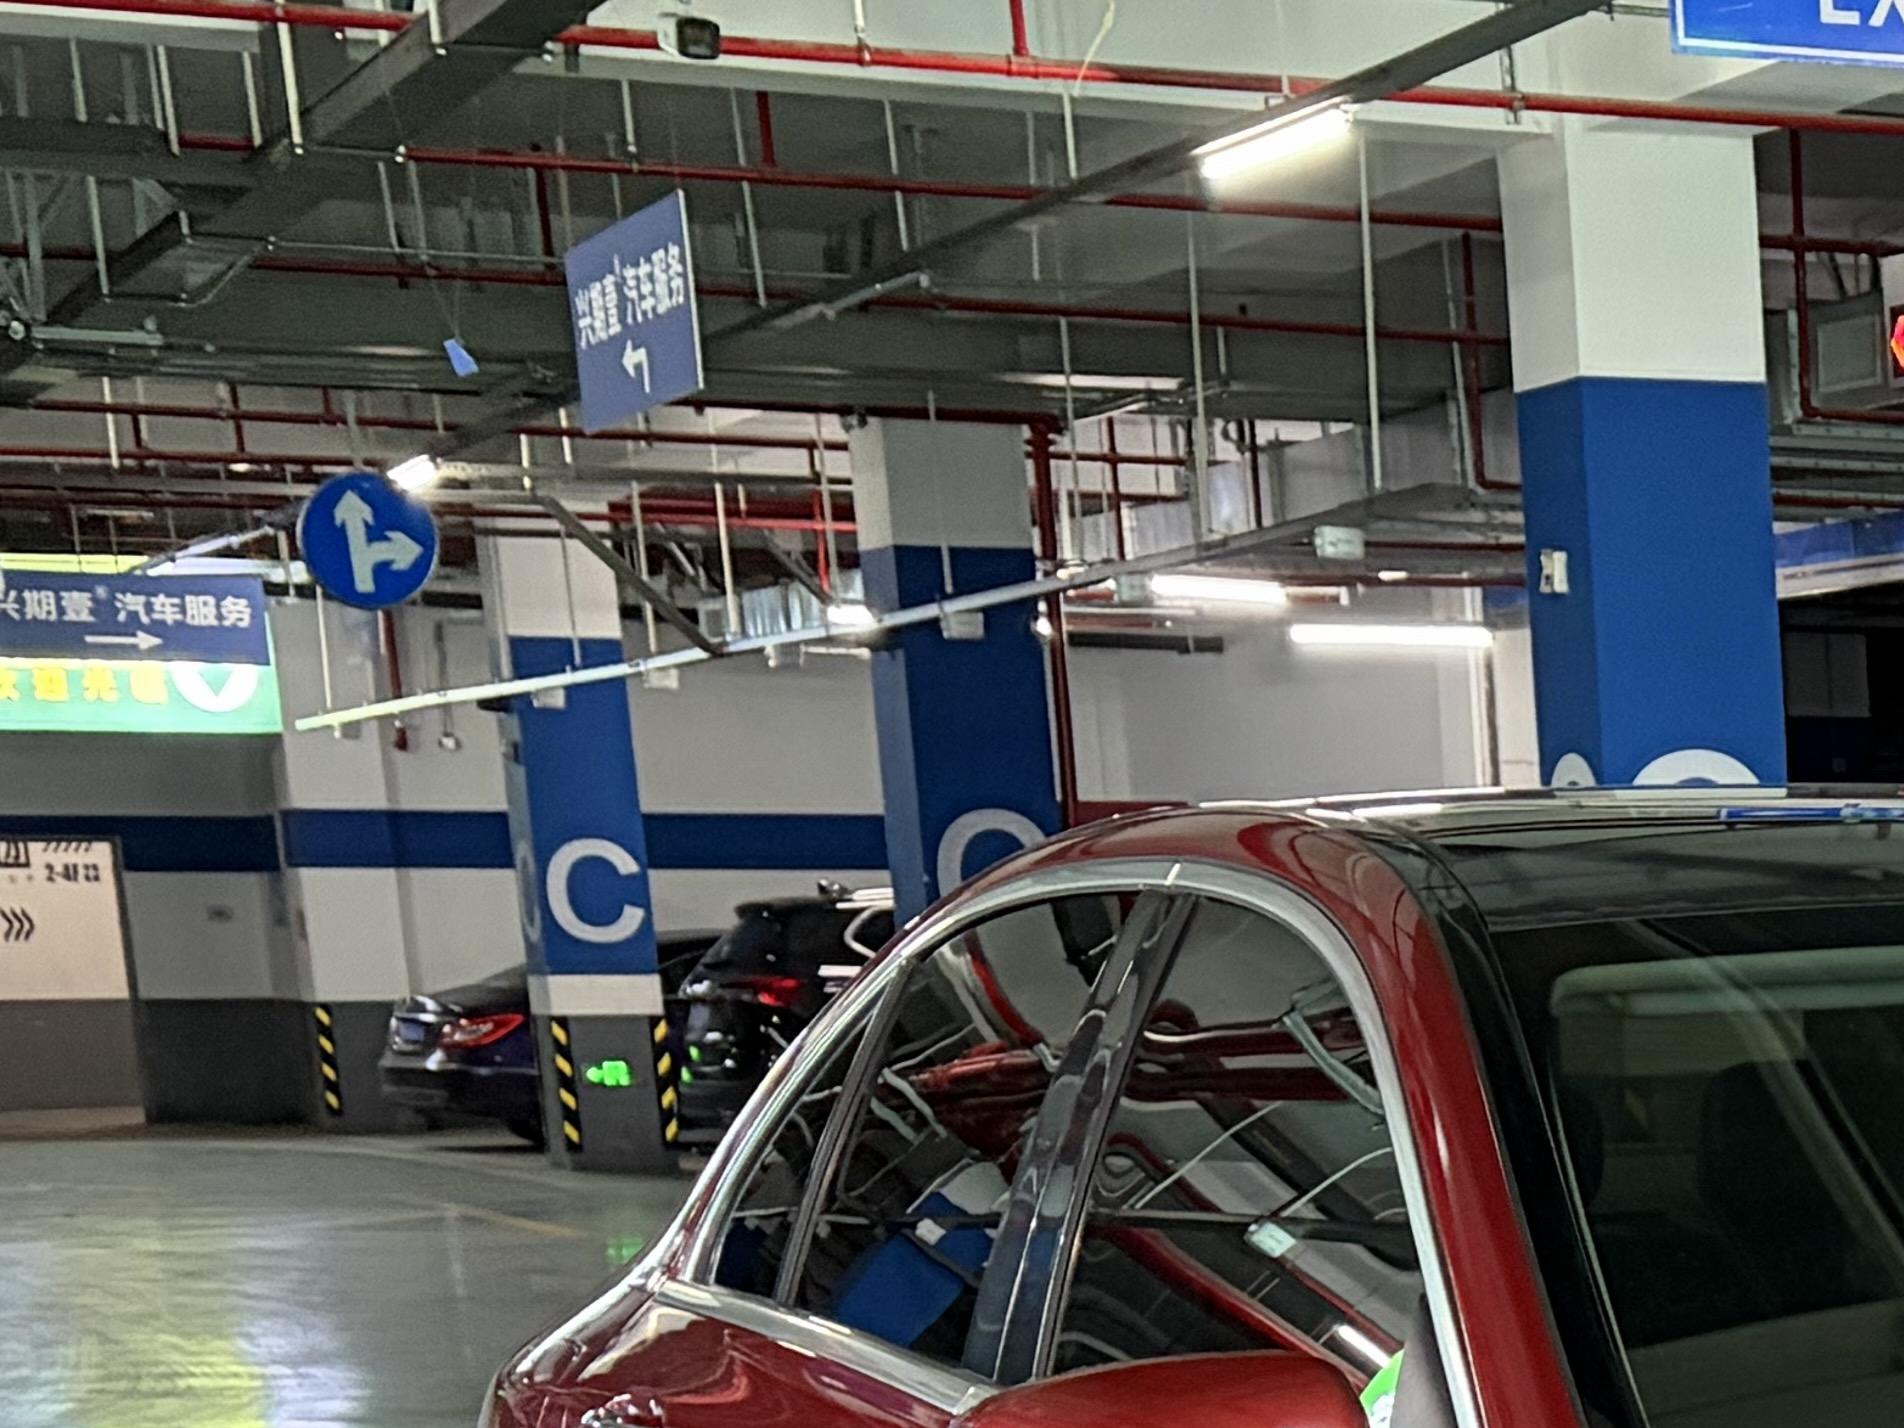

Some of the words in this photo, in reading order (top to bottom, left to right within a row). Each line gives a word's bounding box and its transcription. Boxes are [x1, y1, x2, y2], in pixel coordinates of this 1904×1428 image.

[114, 592, 252, 629] 汽车服务
[546, 837, 645, 943] C
